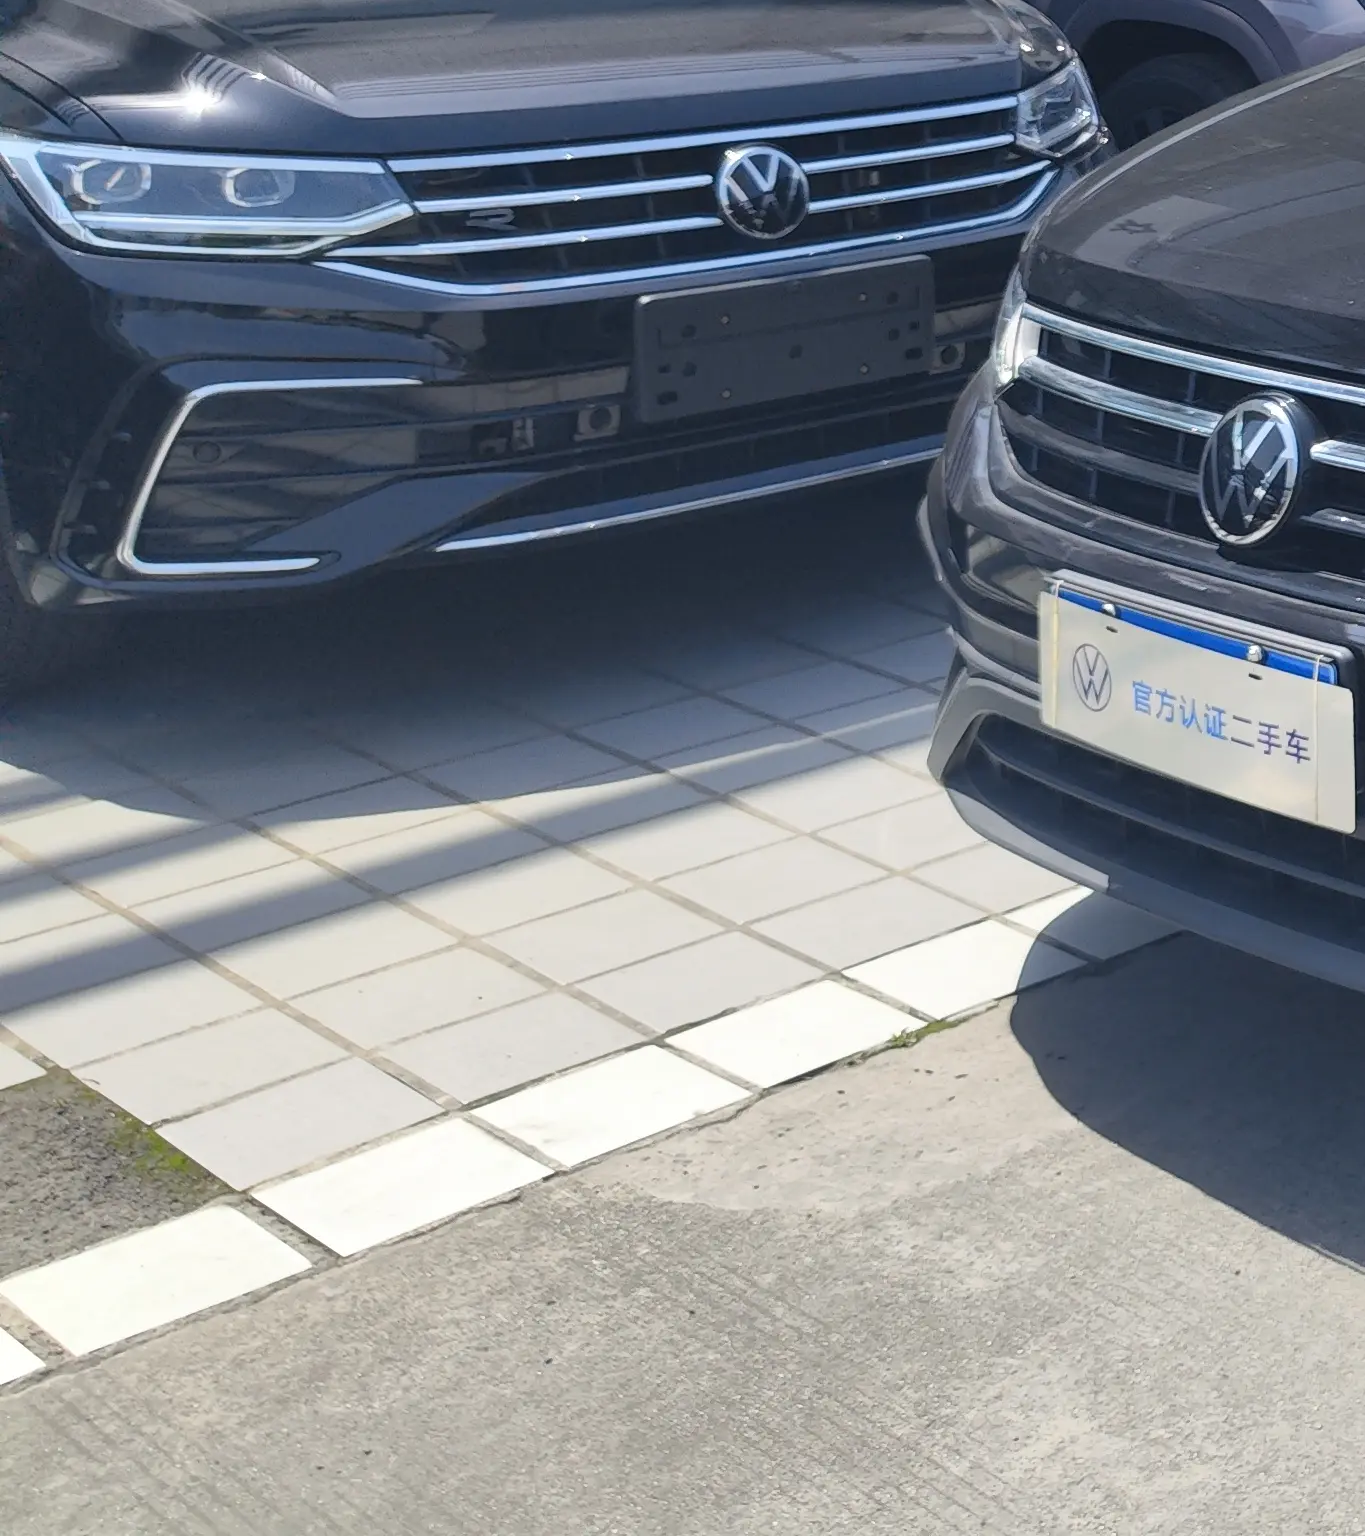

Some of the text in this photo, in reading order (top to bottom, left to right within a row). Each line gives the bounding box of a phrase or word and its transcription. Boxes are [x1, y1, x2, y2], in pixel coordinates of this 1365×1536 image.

[1132, 680, 1311, 765] 官方认证二手车
